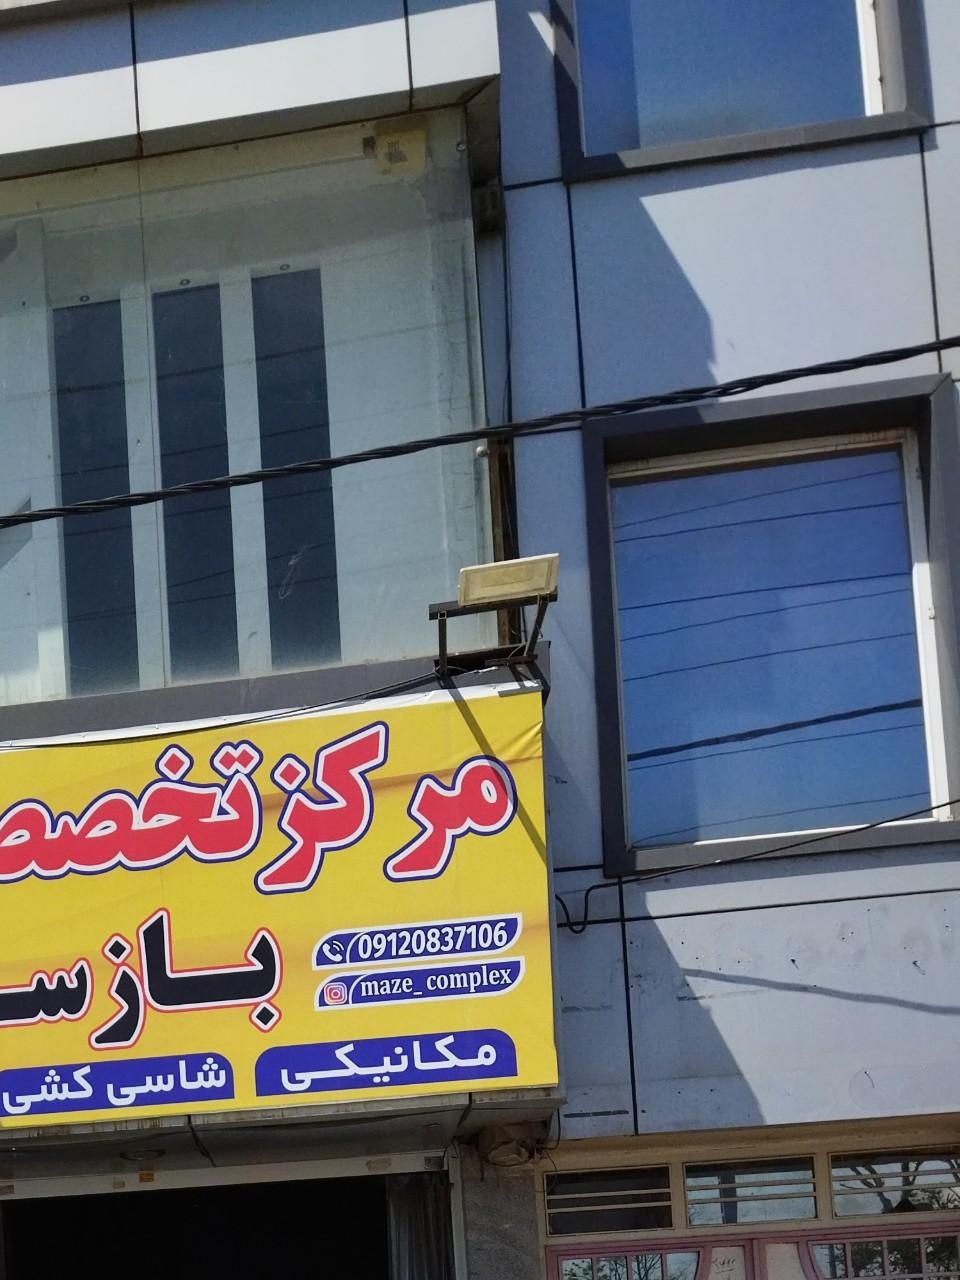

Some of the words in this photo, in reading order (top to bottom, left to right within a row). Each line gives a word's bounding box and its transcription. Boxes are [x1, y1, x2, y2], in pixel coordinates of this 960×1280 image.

[256, 721, 517, 894] مرکز
[357, 921, 508, 960] 09120837106
[107, 1057, 227, 1105] شاسی
[280, 1035, 497, 1092] مکانیکی
[1, 1066, 92, 1115] کشی
